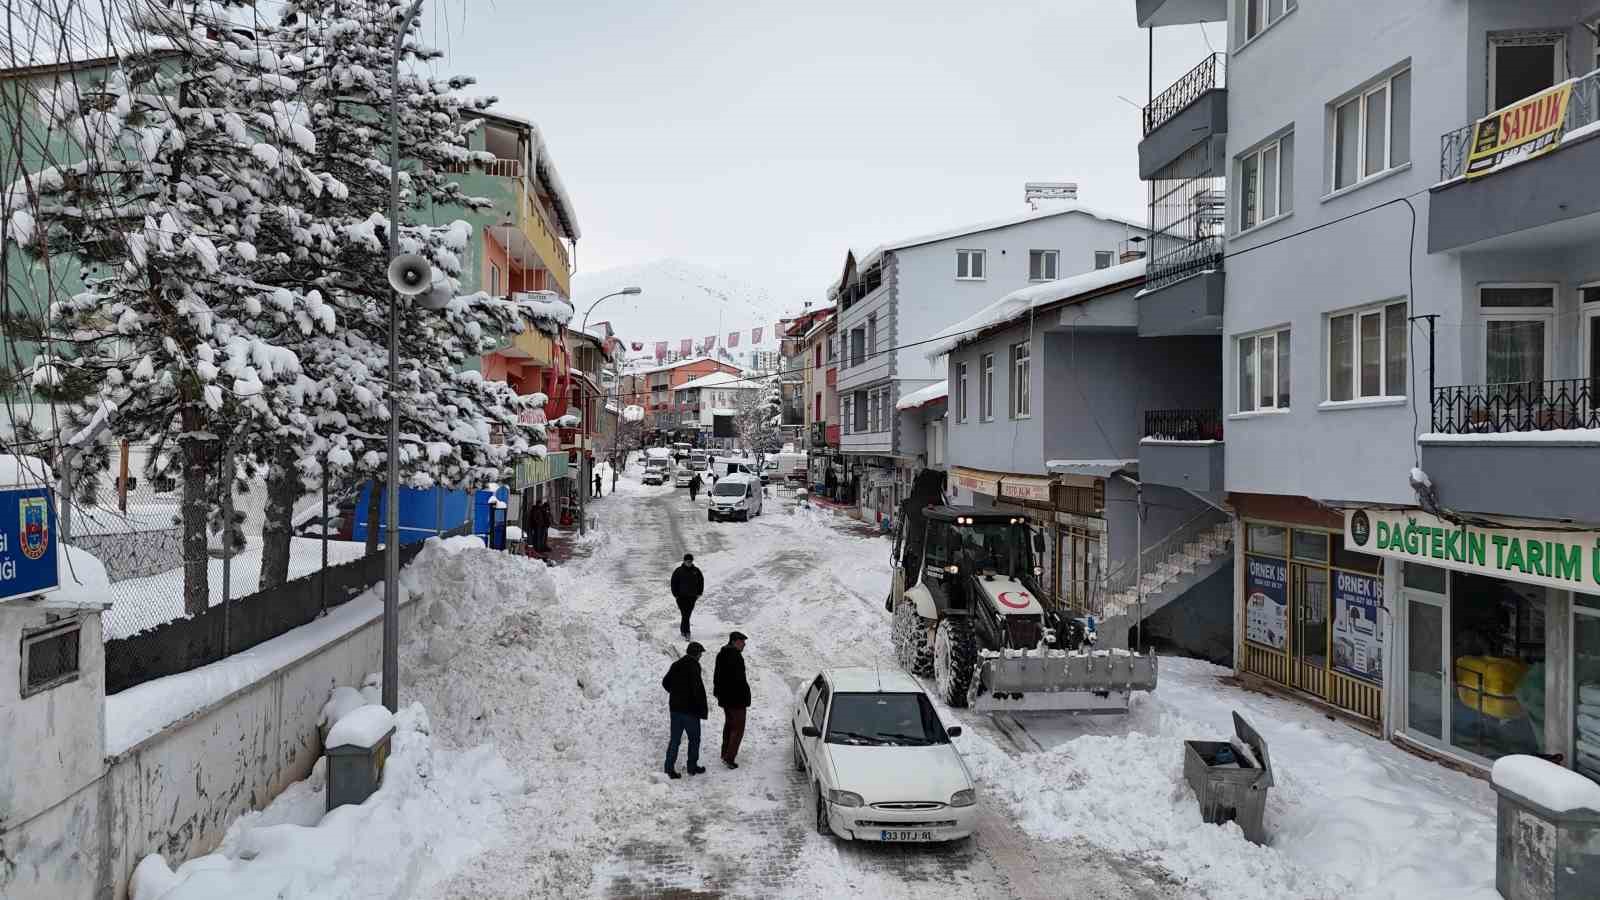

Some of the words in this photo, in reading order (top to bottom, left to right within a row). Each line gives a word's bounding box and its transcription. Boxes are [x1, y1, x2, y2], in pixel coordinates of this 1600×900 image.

[1501, 90, 1564, 145] SATILIK
[1376, 517, 1486, 567] DAĞTEKİN
[1491, 535, 1582, 582] TARIM
[1338, 572, 1371, 596] ÖRNEK
[887, 831, 898, 841] 33
